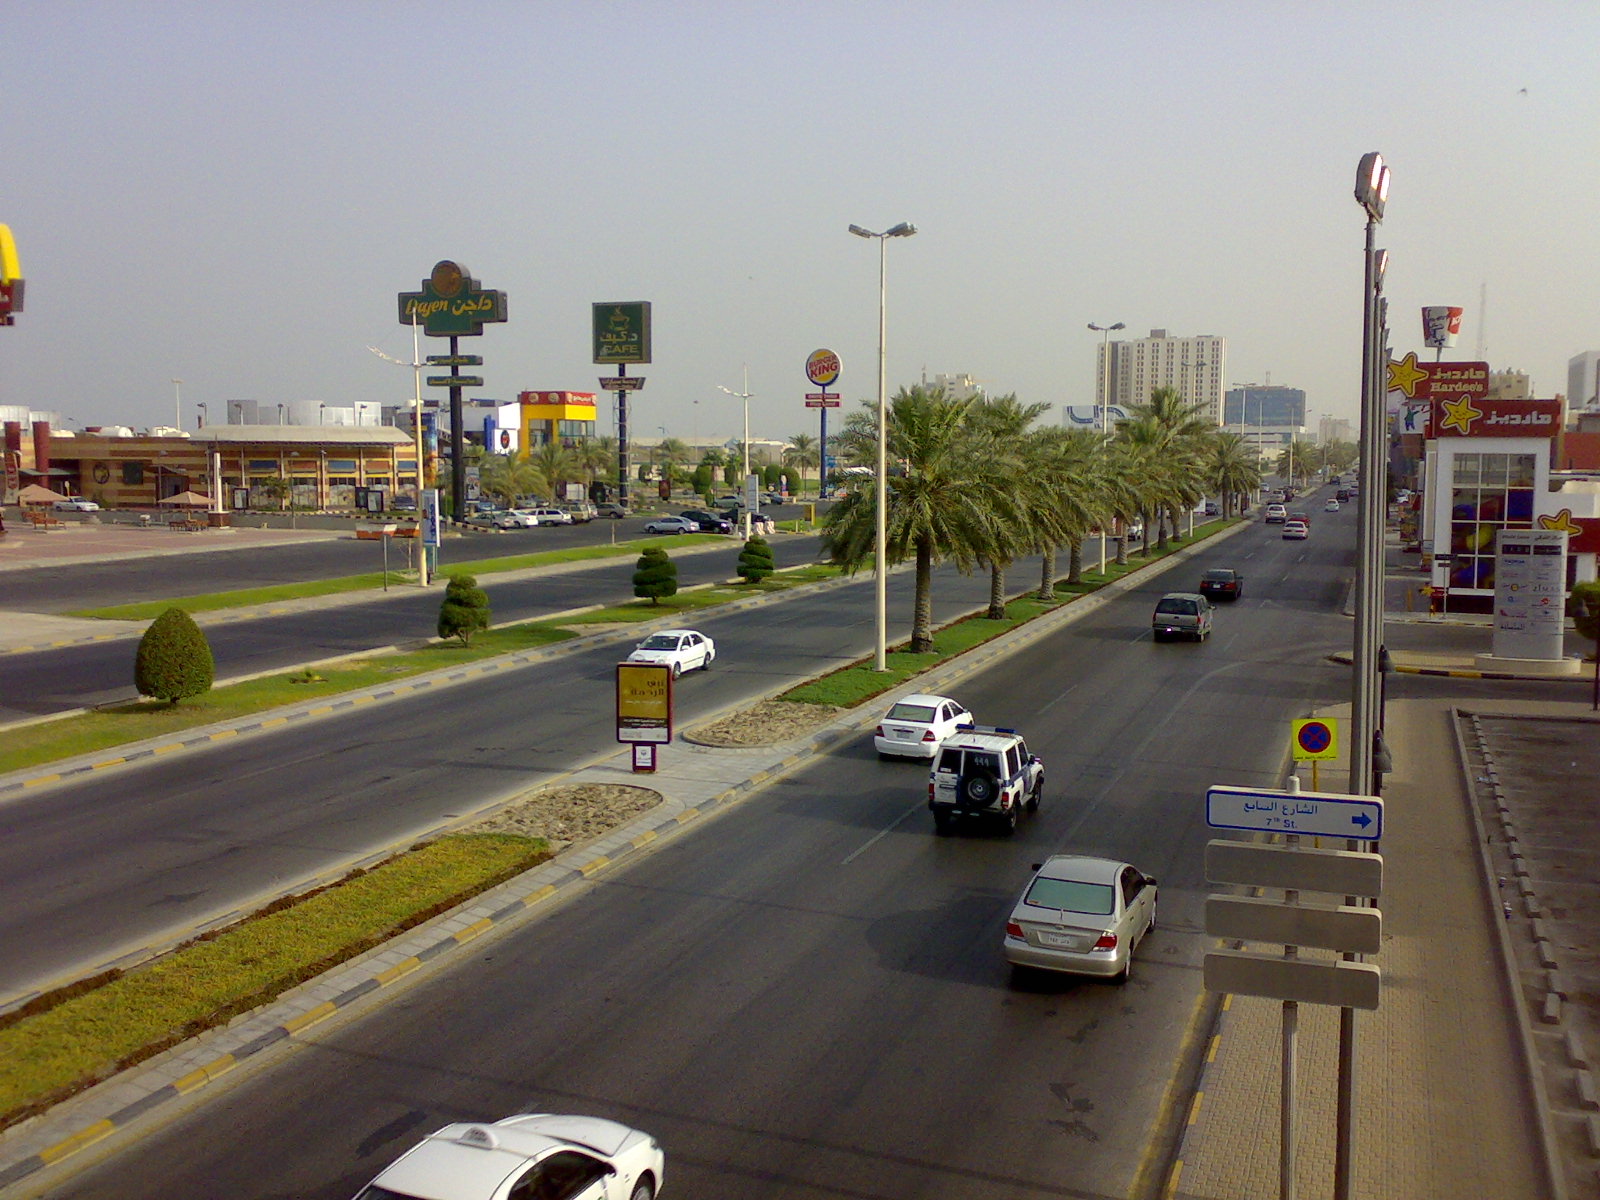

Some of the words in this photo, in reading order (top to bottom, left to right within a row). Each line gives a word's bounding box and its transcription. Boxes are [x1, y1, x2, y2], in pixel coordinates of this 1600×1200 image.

[451, 295, 494, 316] داجن
[810, 362, 838, 379] KING
[1431, 367, 1486, 380] هارديز
[1430, 381, 1485, 392] Hardee's
[1484, 410, 1552, 425] هارديز
[1243, 801, 1277, 812] السابع
[1281, 803, 1318, 815] الشارع
[1266, 817, 1280, 826] 7th
